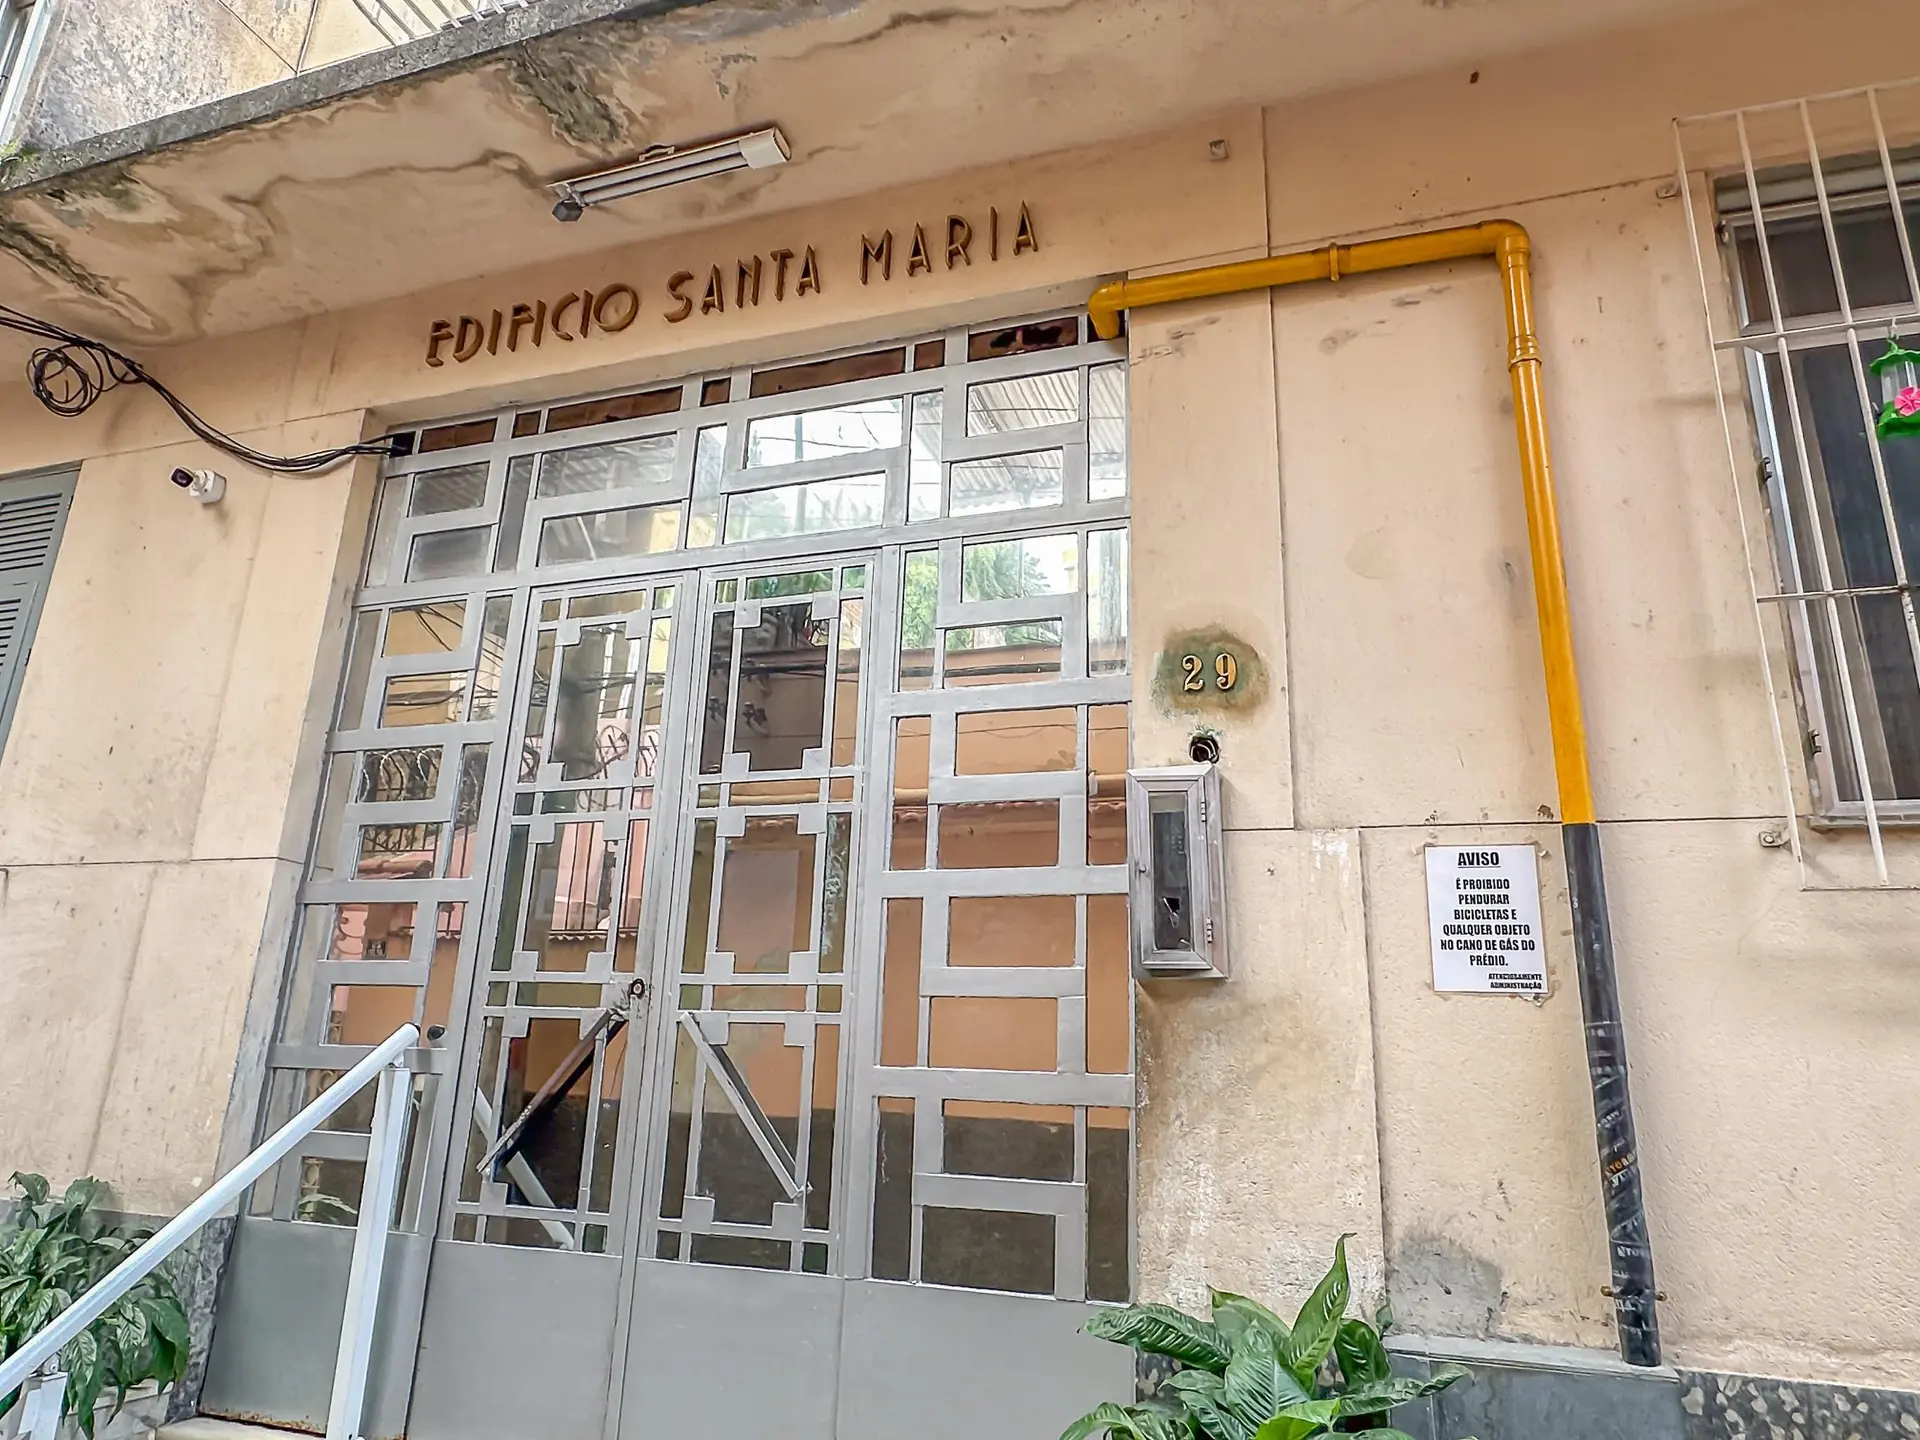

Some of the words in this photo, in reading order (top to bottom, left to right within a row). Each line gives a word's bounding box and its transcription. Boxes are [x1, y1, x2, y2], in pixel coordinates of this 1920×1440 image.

[425, 282, 639, 366] EDIFICIO
[663, 244, 820, 324] SANTA
[860, 200, 1039, 285] MARIA
[1181, 653, 1238, 692] 29
[1458, 852, 1500, 866] AVISO
[1456, 877, 1461, 890] É
[1463, 878, 1510, 890] PROIBIDO
[1458, 894, 1510, 905] PENDURAR
[1454, 909, 1509, 920] BICICLETAS
[1511, 909, 1517, 920] E
[1443, 924, 1492, 936] QUALQUER
[1495, 924, 1530, 936] OBJETO
[1440, 939, 1454, 951] NO
[1456, 939, 1482, 951] CANO
[1485, 939, 1498, 951] DE
[1499, 938, 1519, 951] GÁS
[1521, 940, 1535, 951] DO
[1470, 953, 1508, 966] PRÉDIO.
